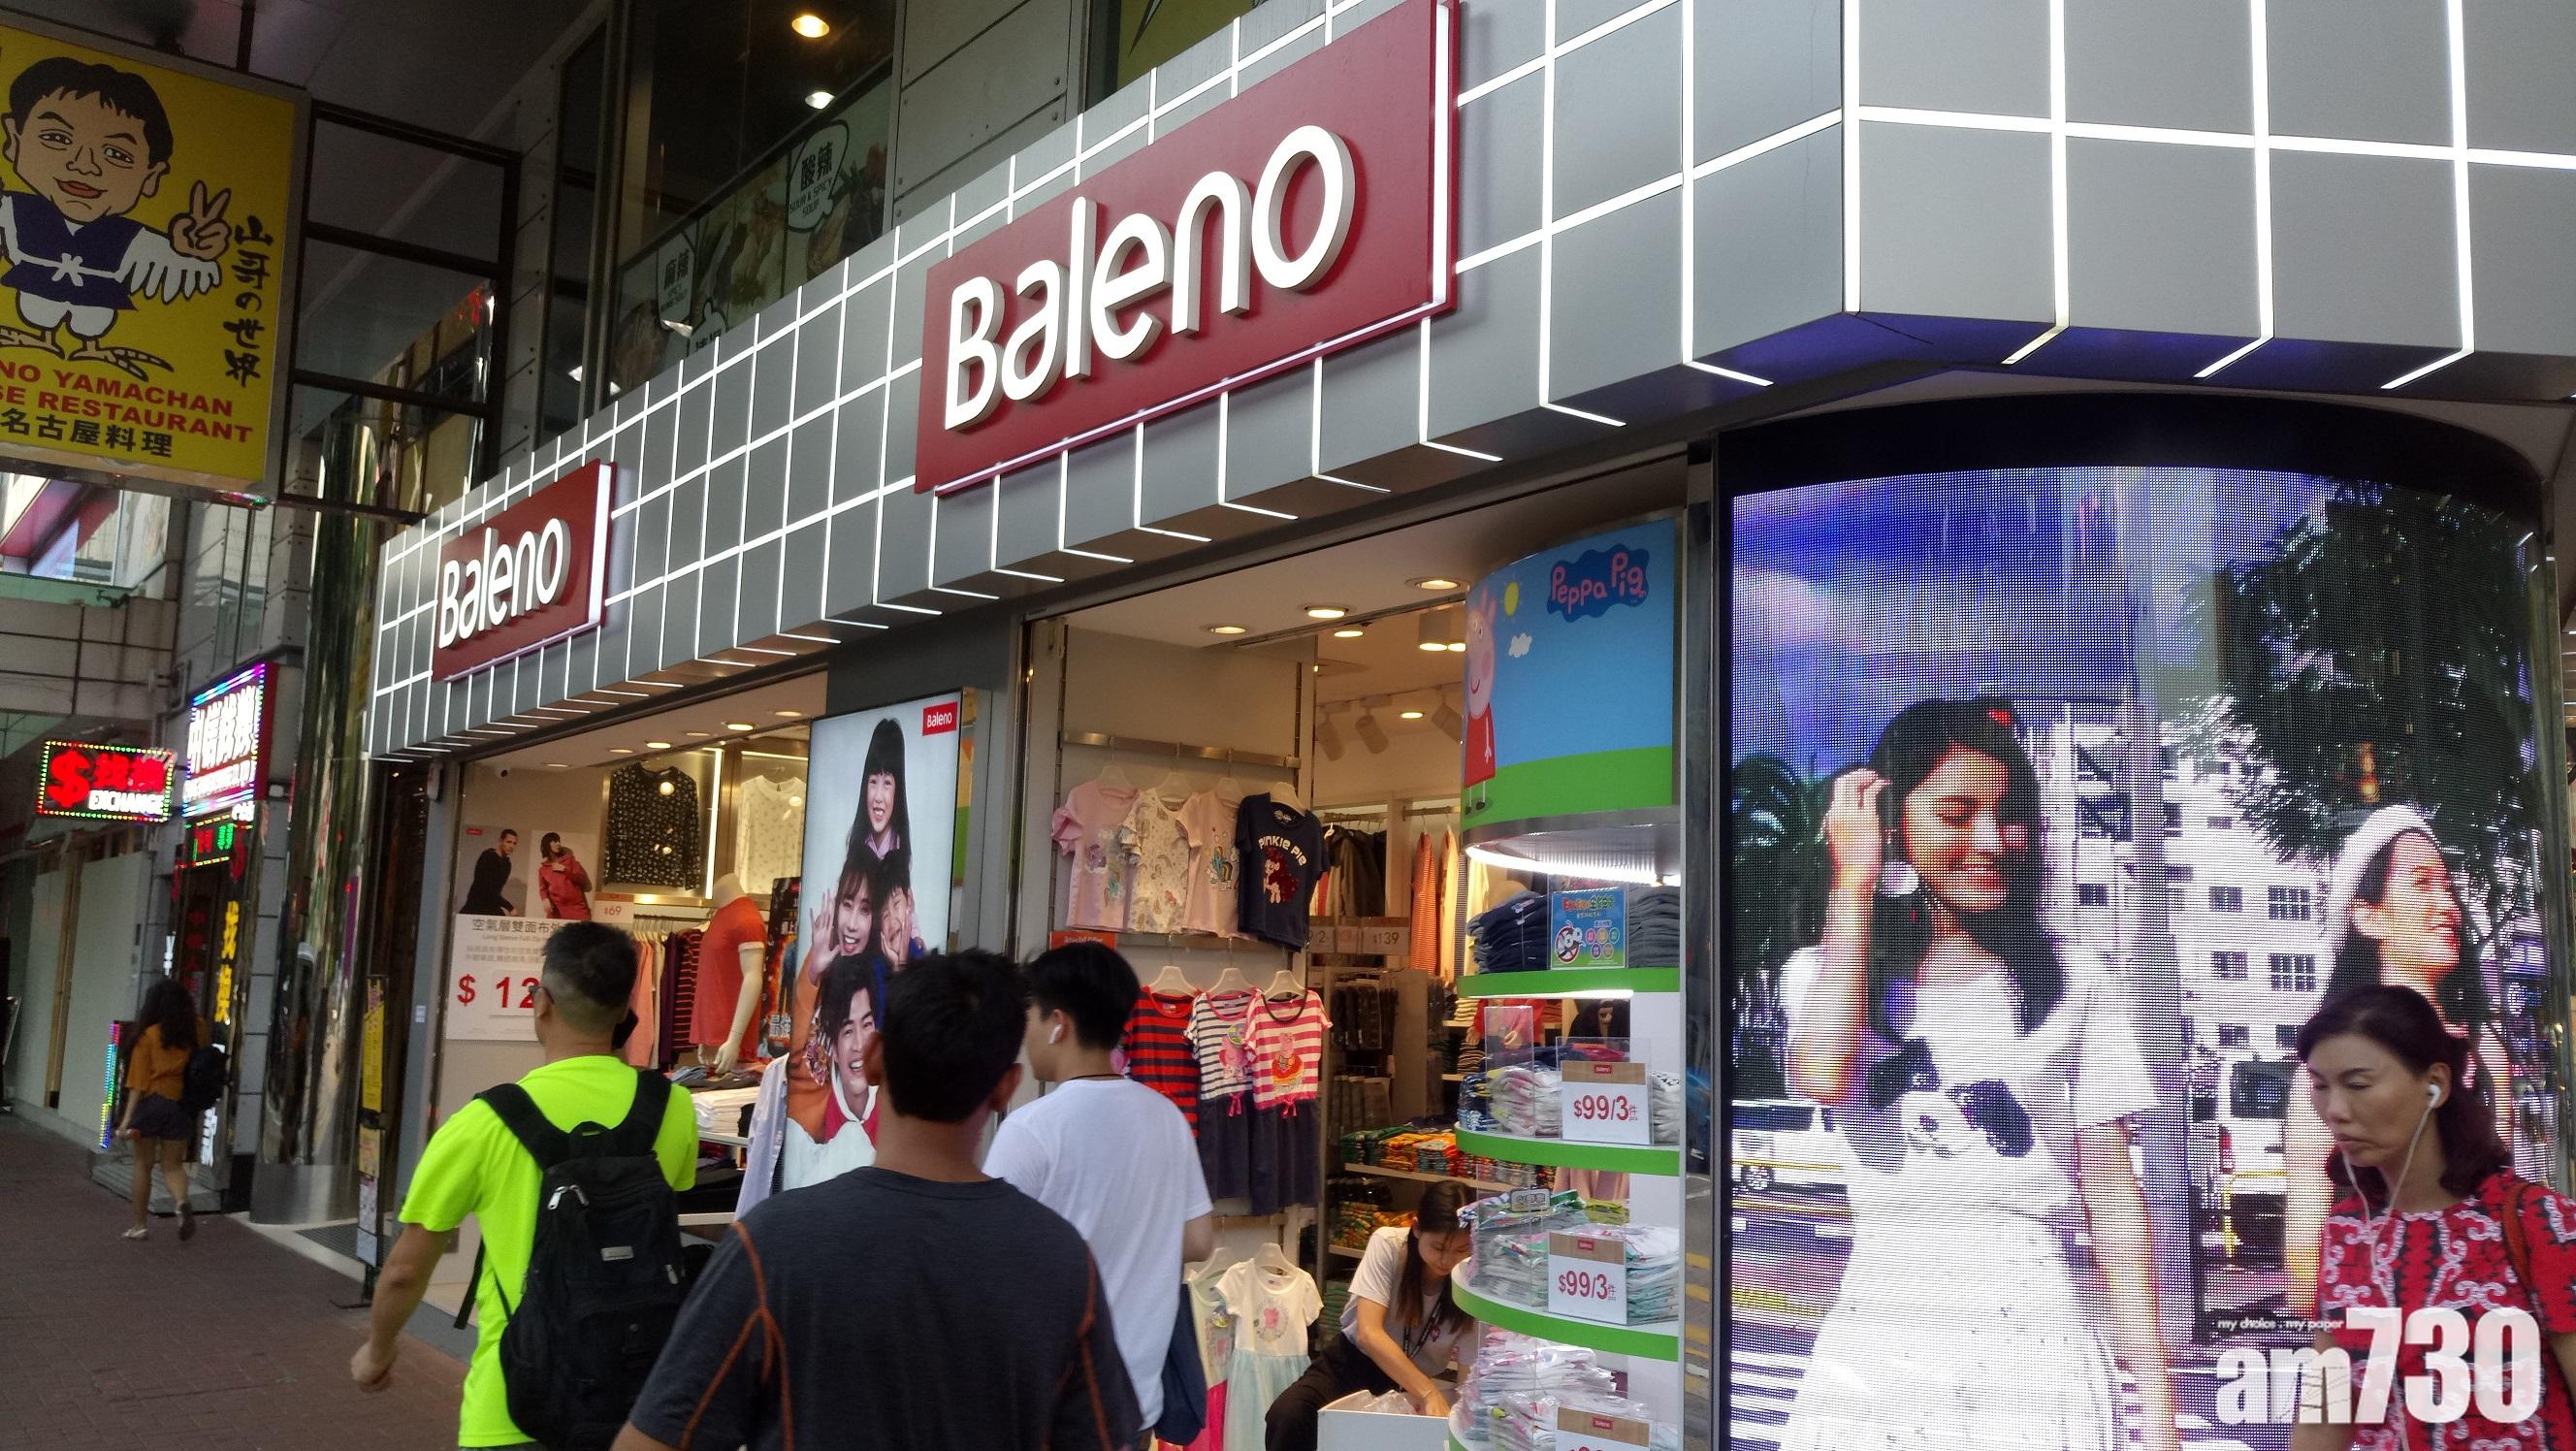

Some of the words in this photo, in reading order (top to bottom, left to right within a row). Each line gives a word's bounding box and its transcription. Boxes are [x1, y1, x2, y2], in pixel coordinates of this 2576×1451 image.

[945, 125, 1355, 431] Baleno
[39, 391, 253, 443] RESTAURANT
[52, 369, 233, 417] YAMACHAN
[1, 407, 173, 458] 名古屋料理
[438, 518, 571, 649] Baleno
[1552, 564, 1609, 615] Peppa
[1611, 551, 1647, 597] Pig
[926, 711, 952, 728] Baleno
[88, 790, 165, 816] EXCHANGE
